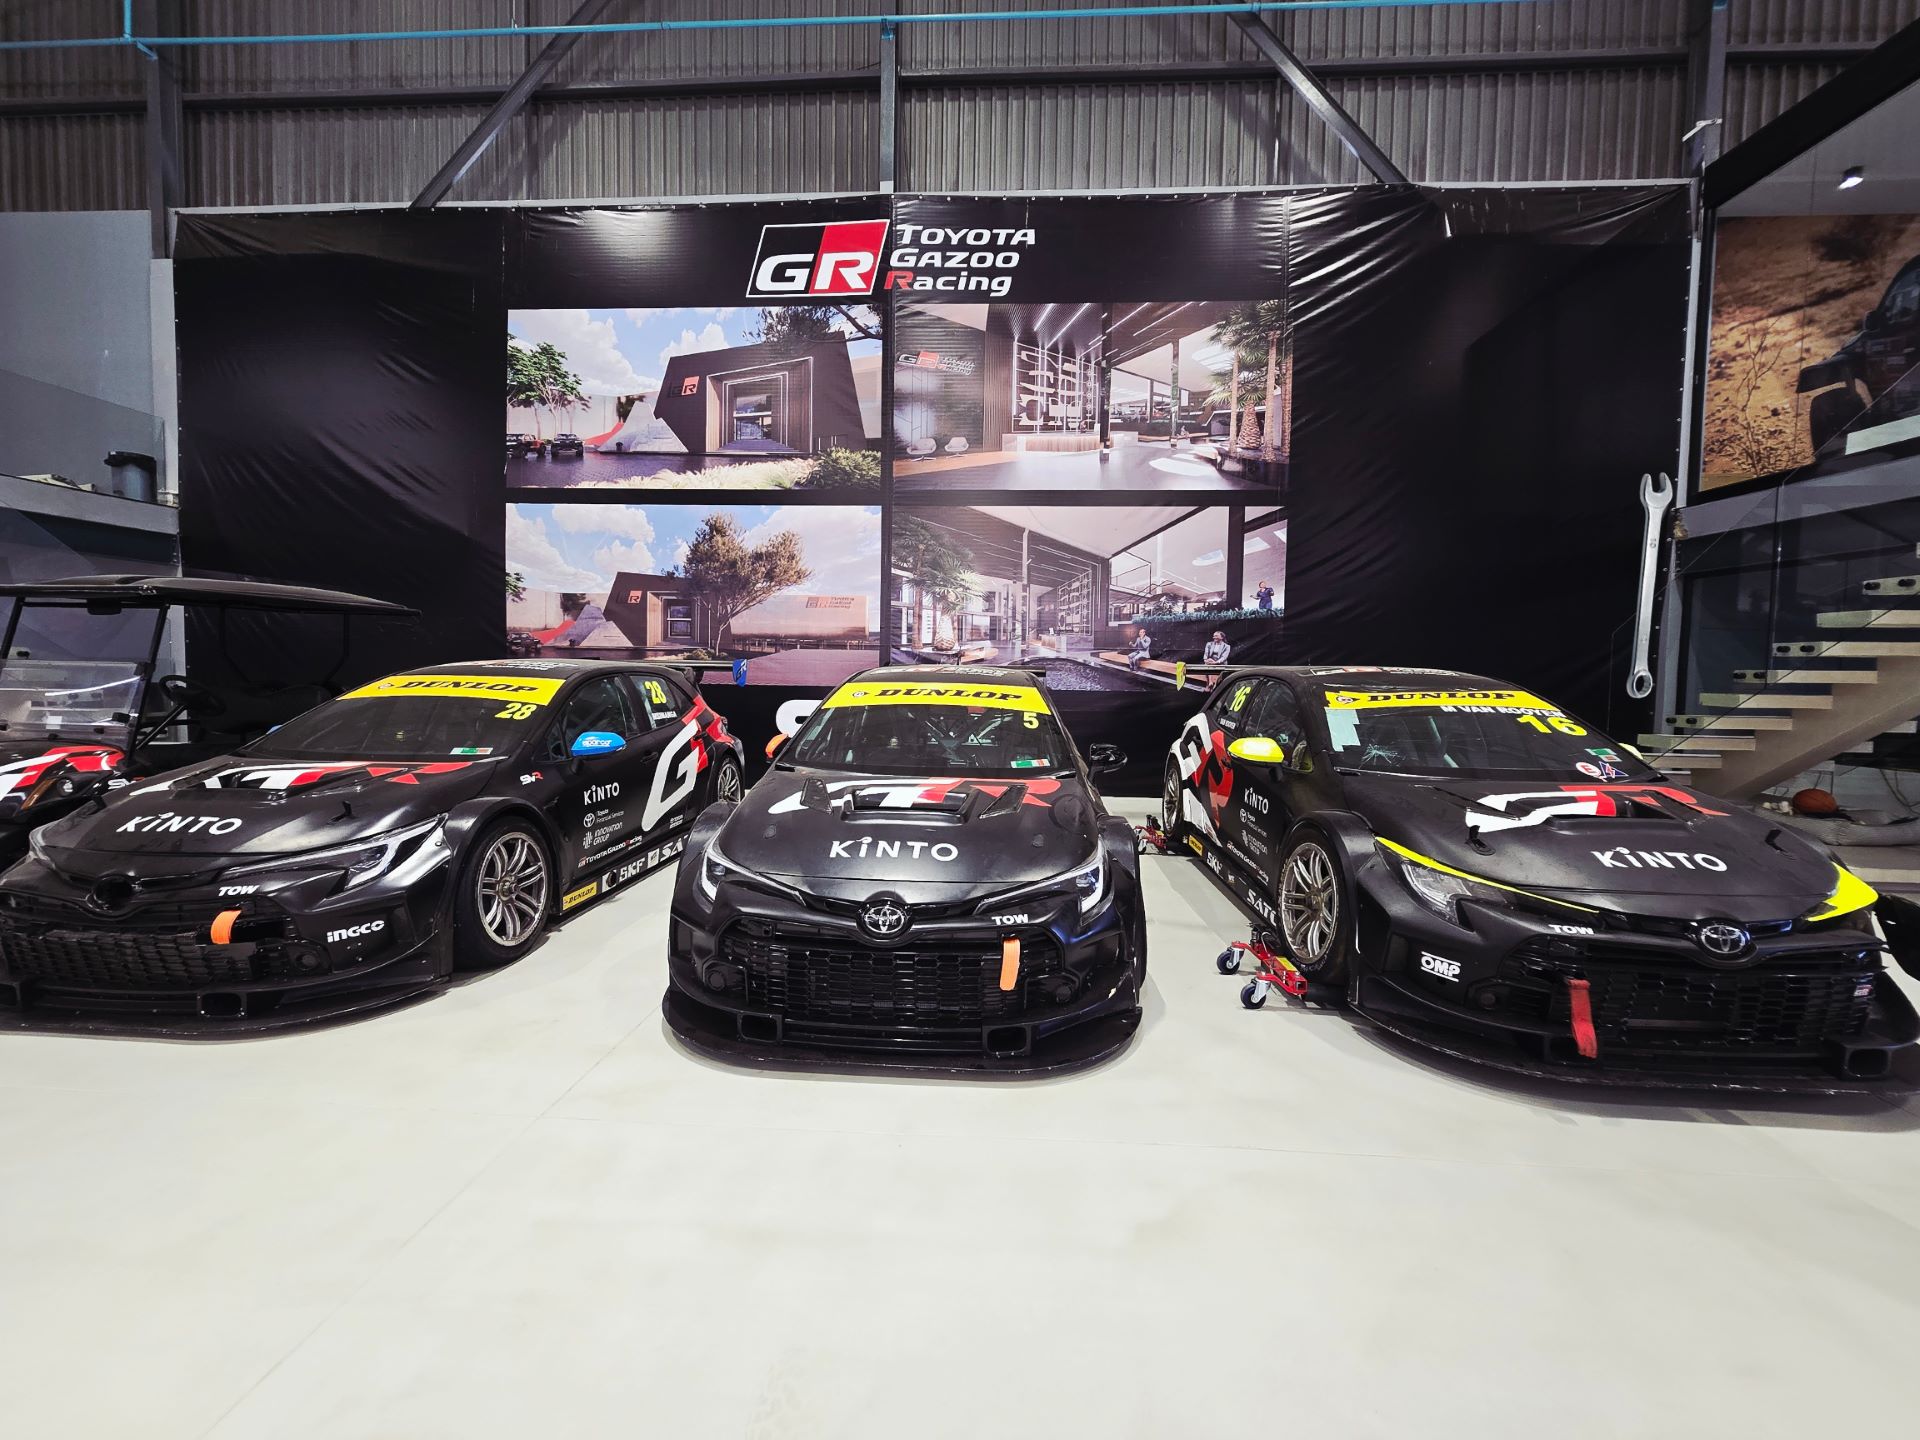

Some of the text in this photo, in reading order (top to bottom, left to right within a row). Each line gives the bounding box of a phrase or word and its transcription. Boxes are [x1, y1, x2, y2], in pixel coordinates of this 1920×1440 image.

[897, 225, 1036, 246] TOYOTA
[889, 248, 1020, 268] GAZOO
[755, 251, 874, 291] GR
[884, 270, 1013, 297] Racing
[397, 680, 540, 694] DUNLOP
[644, 680, 667, 704] 28
[875, 688, 1022, 701] DUNLOP
[1230, 685, 1252, 712] 16
[1367, 692, 1515, 702] DUNLOP
[494, 702, 538, 721] 28
[1457, 706, 1497, 714] VAN
[1023, 711, 1040, 729] 5
[1517, 714, 1588, 736] 16
[619, 857, 646, 883] SKF
[218, 884, 261, 898] TOW
[992, 913, 1029, 926] TOW
[1548, 923, 1595, 936] TOW
[1421, 953, 1461, 978] OMP
